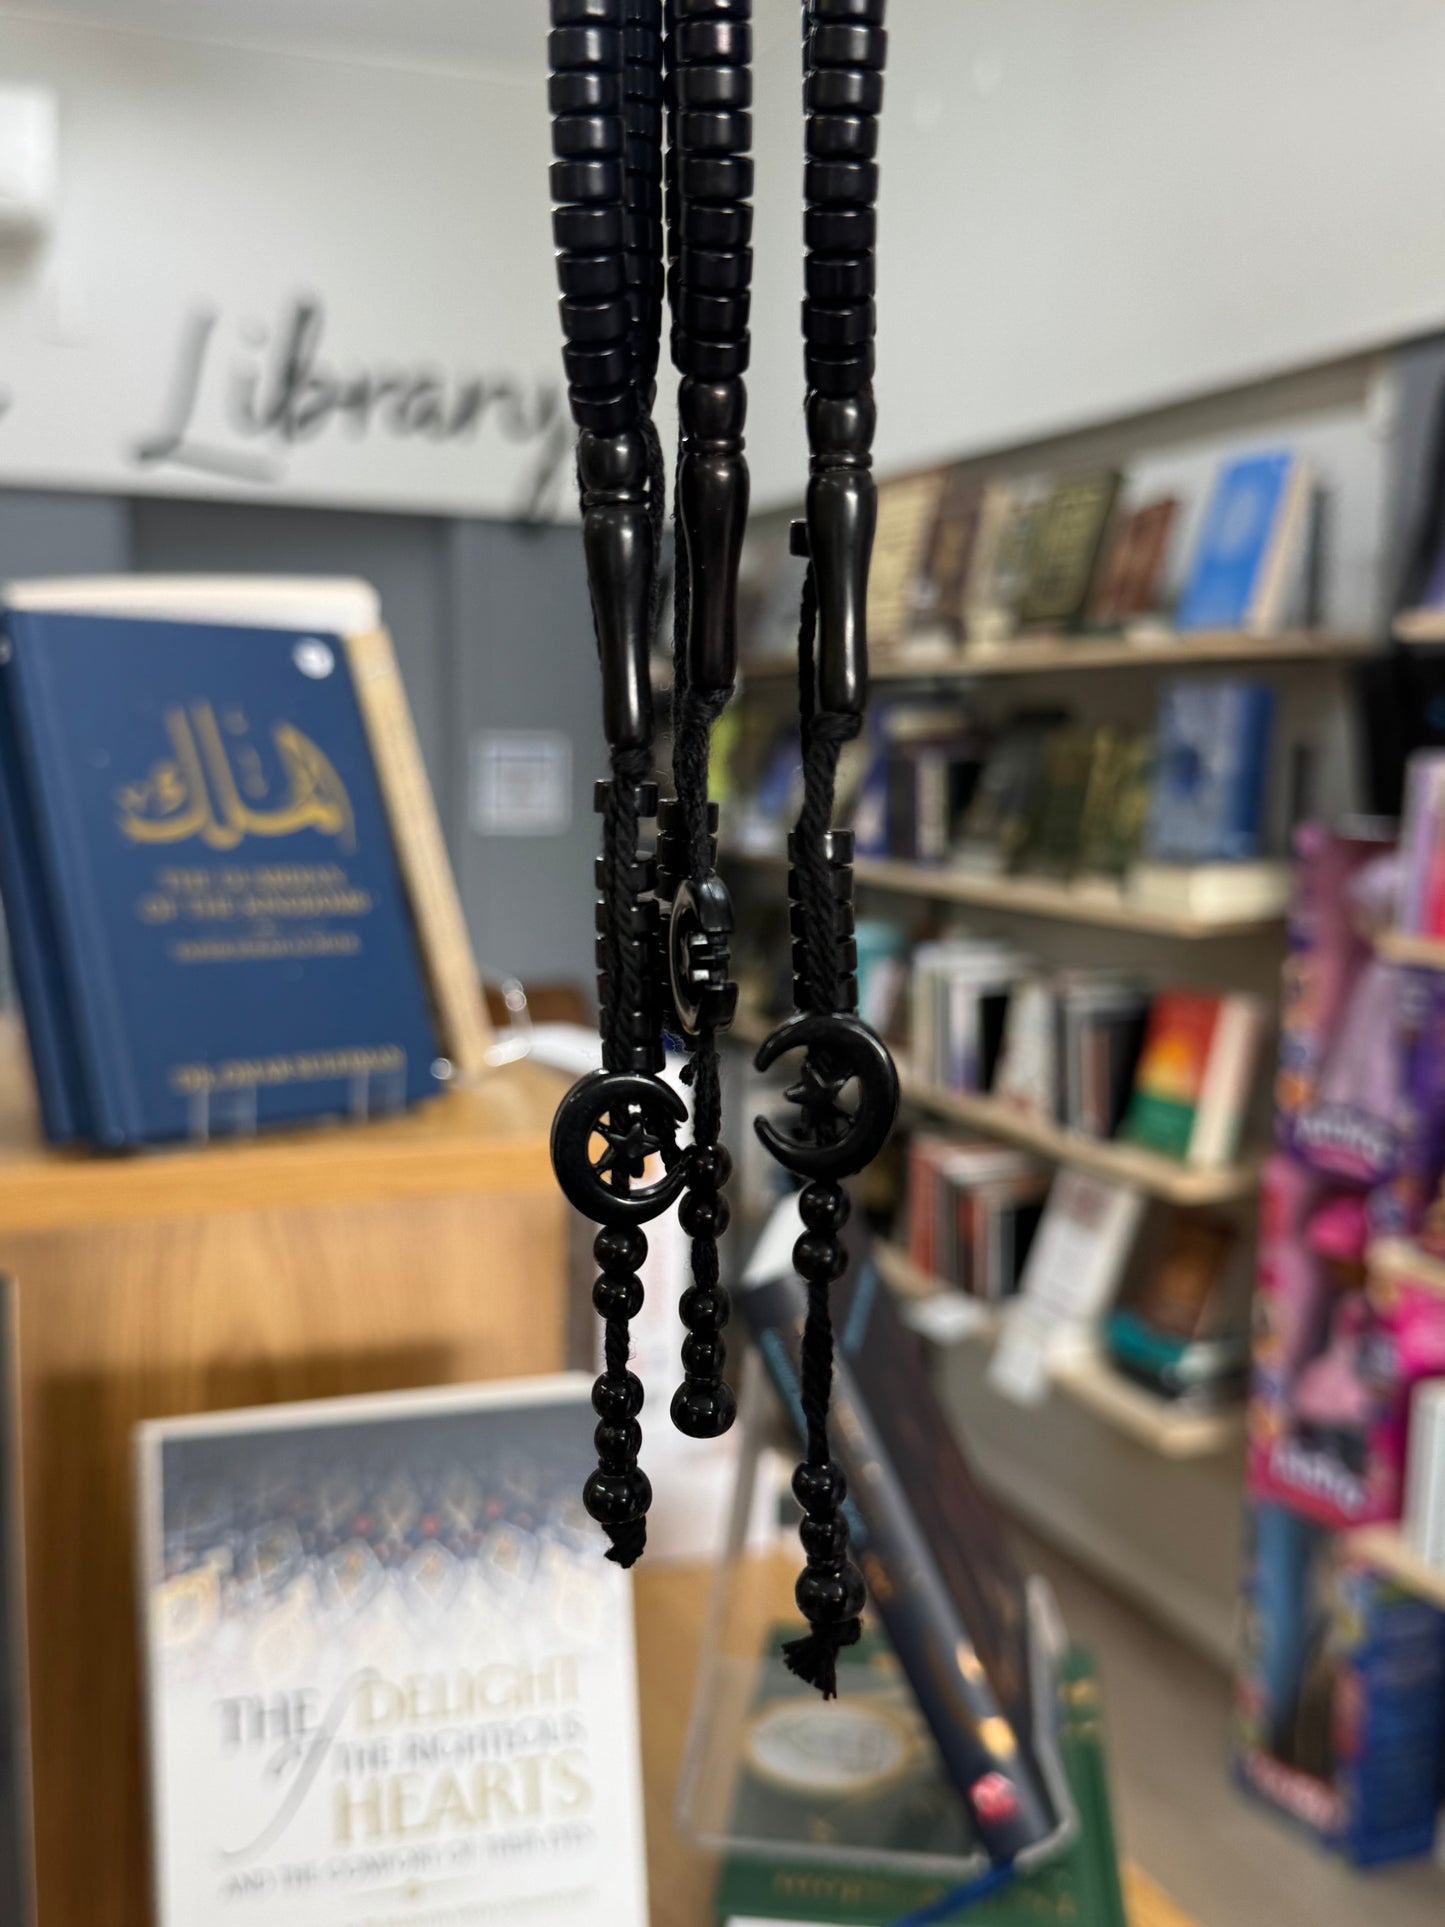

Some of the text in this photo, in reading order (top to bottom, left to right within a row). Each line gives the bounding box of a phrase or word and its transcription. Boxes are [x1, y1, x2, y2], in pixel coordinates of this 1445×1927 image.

[130, 293, 572, 532] Library
[214, 1654, 581, 1752] THE DELIGHT
[332, 1749, 595, 1847] HEARTS
